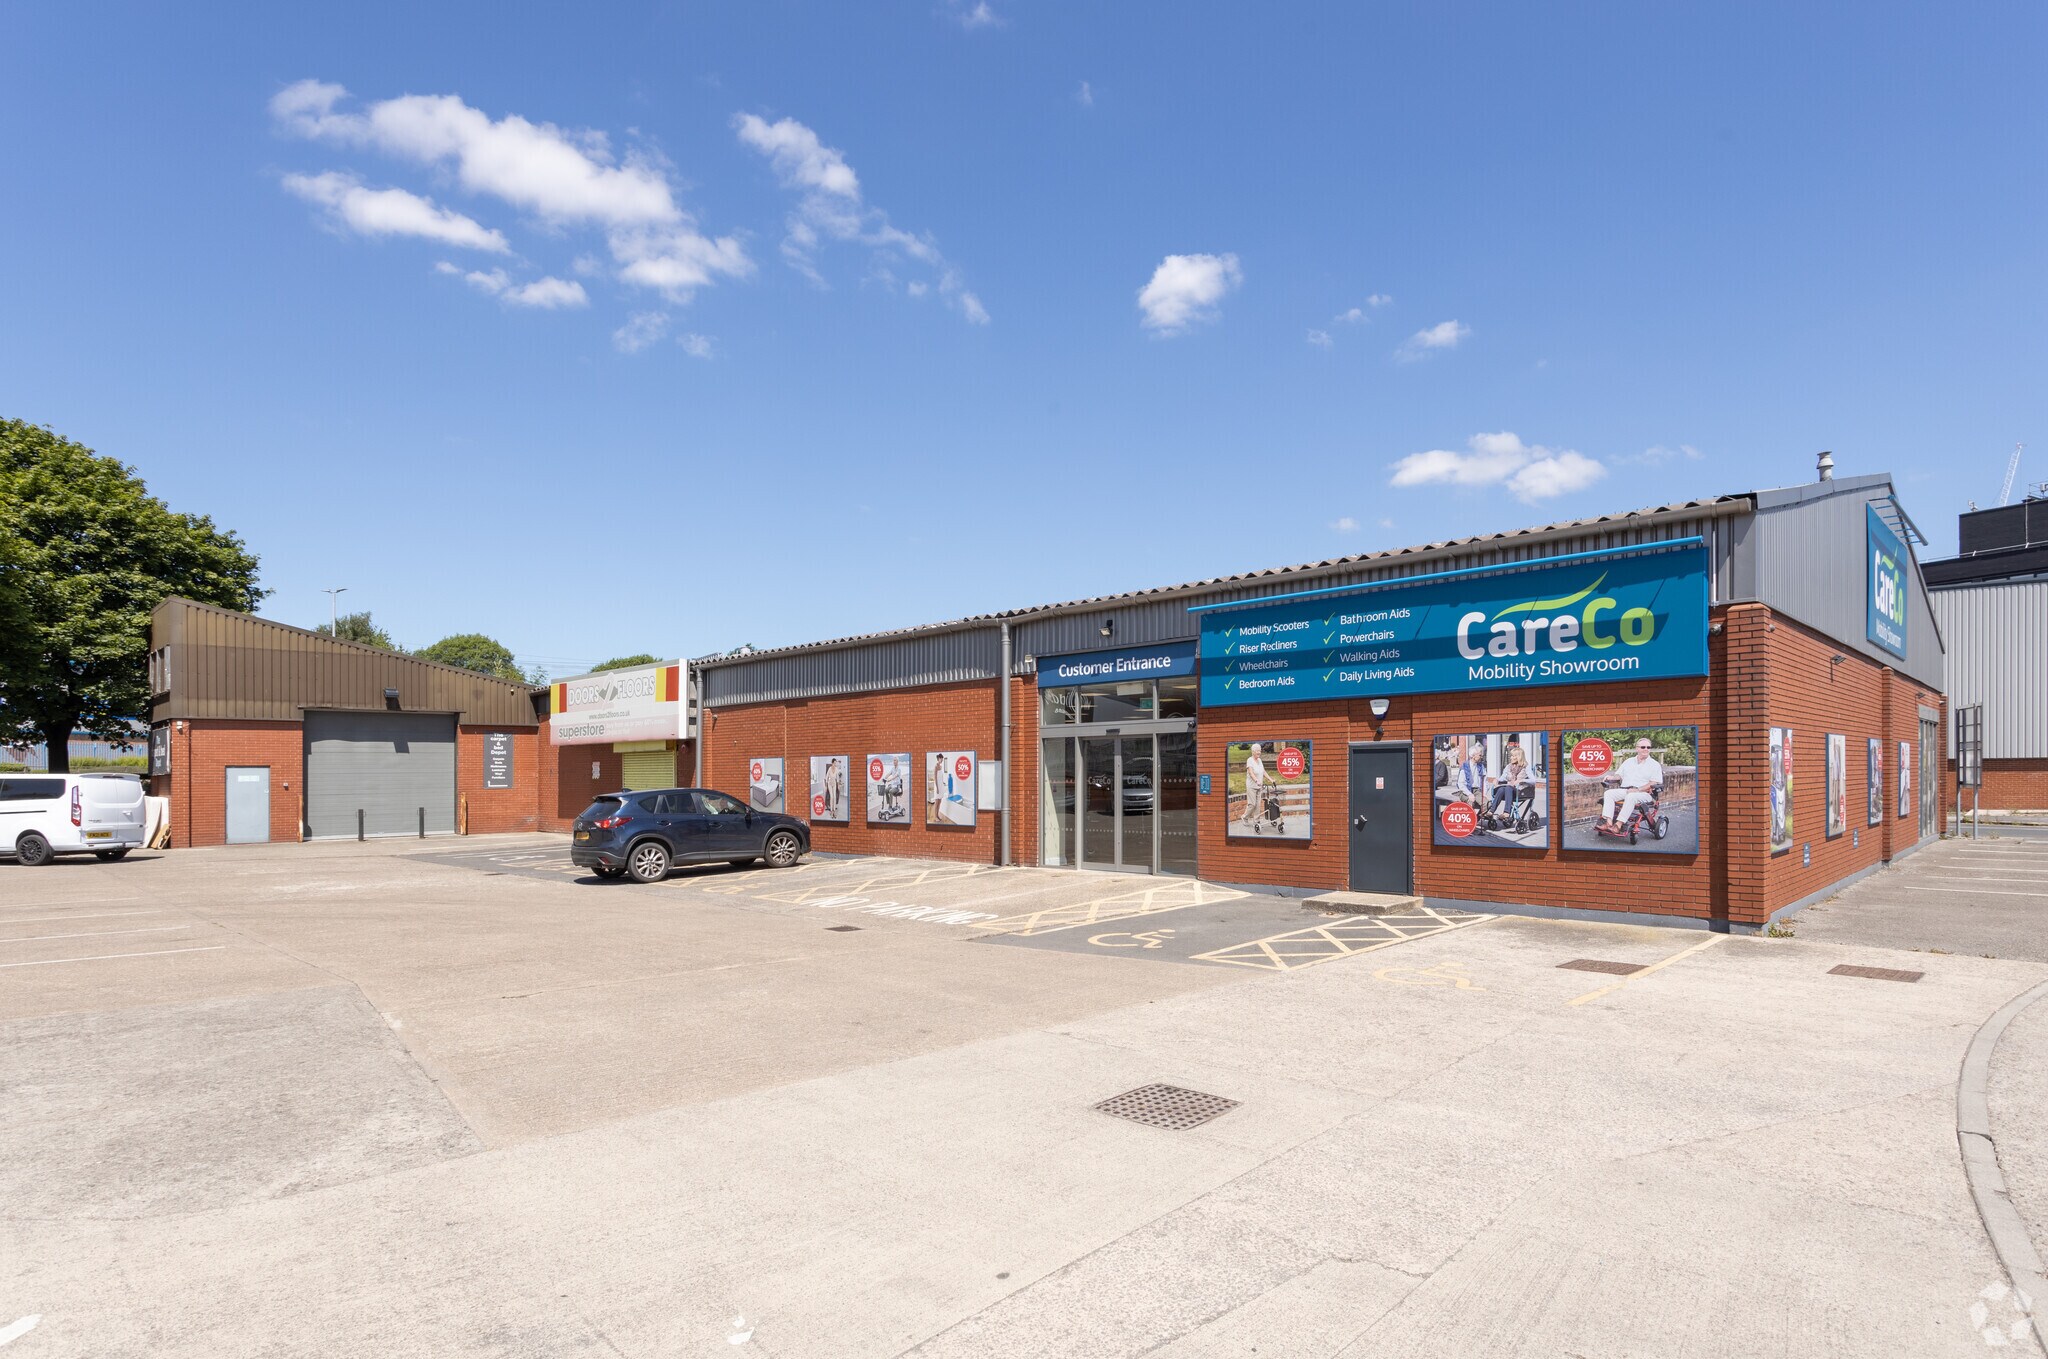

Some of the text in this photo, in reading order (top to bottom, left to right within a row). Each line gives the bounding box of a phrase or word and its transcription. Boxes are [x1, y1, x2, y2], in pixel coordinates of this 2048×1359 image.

[1874, 550, 1904, 626] CareCo
[1340, 608, 1411, 625] Bathroom Aids
[1239, 620, 1310, 636] Mobility Scooters
[1457, 597, 1655, 660] CareCo
[1340, 630, 1395, 644] Powerchairs
[1239, 639, 1298, 654] Riser Recliners
[1340, 648, 1401, 663] Walking Aids
[1058, 656, 1171, 678] Customer Entrance
[1239, 658, 1289, 671] Wheelchairs
[1469, 656, 1639, 681] Mobility Showroom
[1340, 667, 1415, 682] Daily Living Aids
[1239, 676, 1295, 689] Bedroom Aids
[569, 685, 600, 706] DOORS
[617, 676, 656, 699] FLOORS
[588, 709, 631, 721] www.doors2floors.co.uk
[559, 723, 605, 739] superstore
[1281, 757, 1300, 767] 45%
[1578, 750, 1605, 761] 45%
[957, 763, 969, 771] 50%
[1088, 776, 1111, 785] CareCo
[1127, 776, 1151, 785] CareCo
[1447, 813, 1471, 823] 40%
[799, 896, 999, 925] NO PARKING
